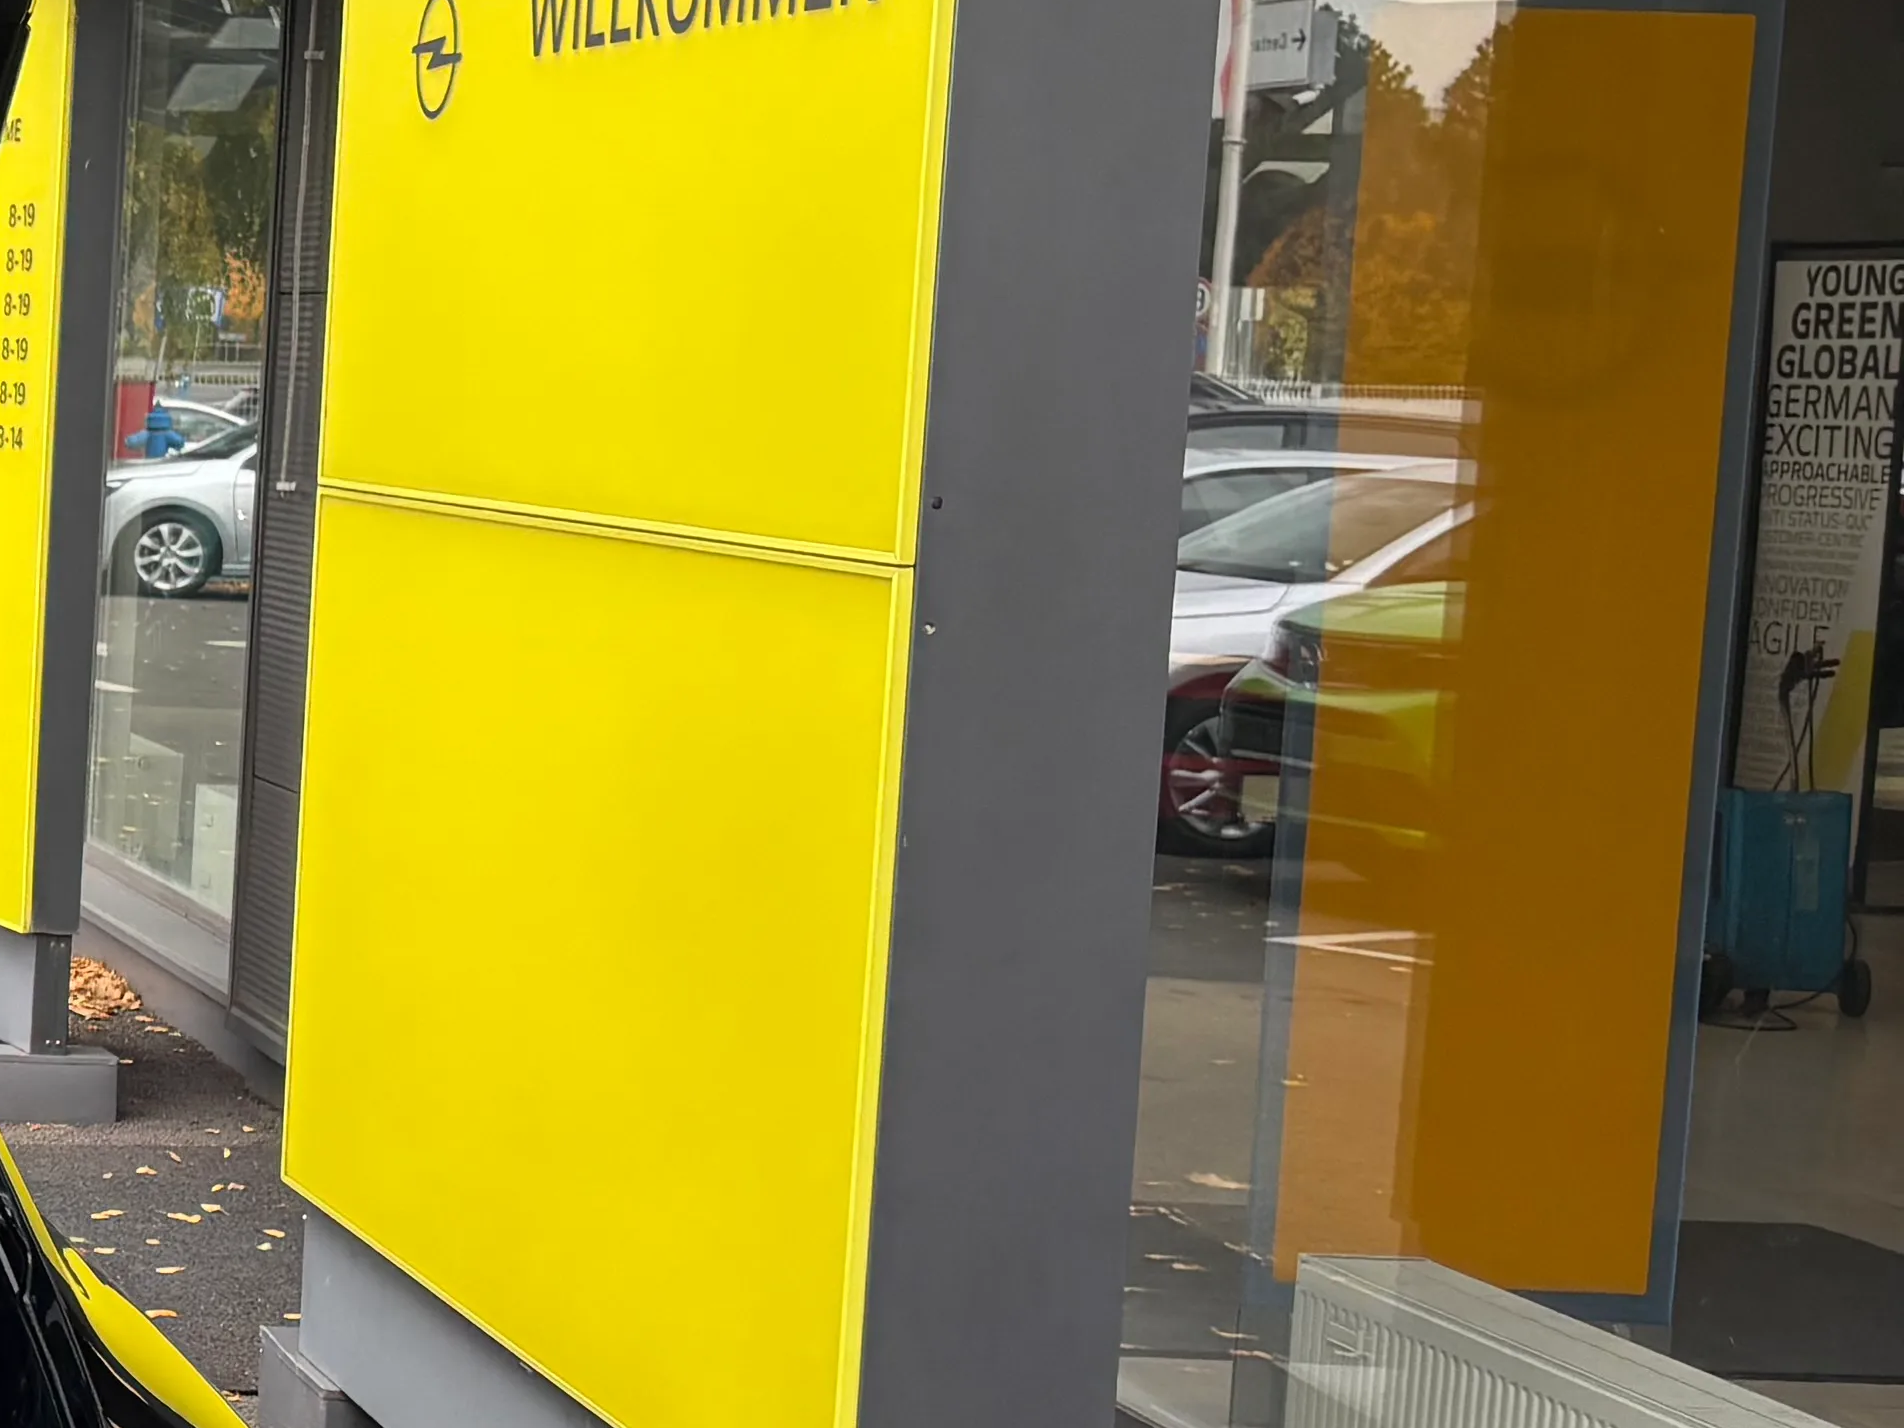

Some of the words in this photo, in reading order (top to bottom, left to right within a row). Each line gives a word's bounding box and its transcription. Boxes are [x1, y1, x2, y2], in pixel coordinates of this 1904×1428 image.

[8, 202, 36, 228] 8-19
[6, 247, 33, 272] 8-19
[1806, 263, 1904, 298] YOUNG
[3, 292, 31, 317] 8-19
[1792, 300, 1904, 340] GREEN
[1, 336, 29, 362] 8-19
[1776, 343, 1900, 380] GLOBAL
[1767, 383, 1895, 421] GERMAN
[1764, 423, 1894, 460] EXCITING
[1765, 484, 1882, 510] ROGRESSIVE
